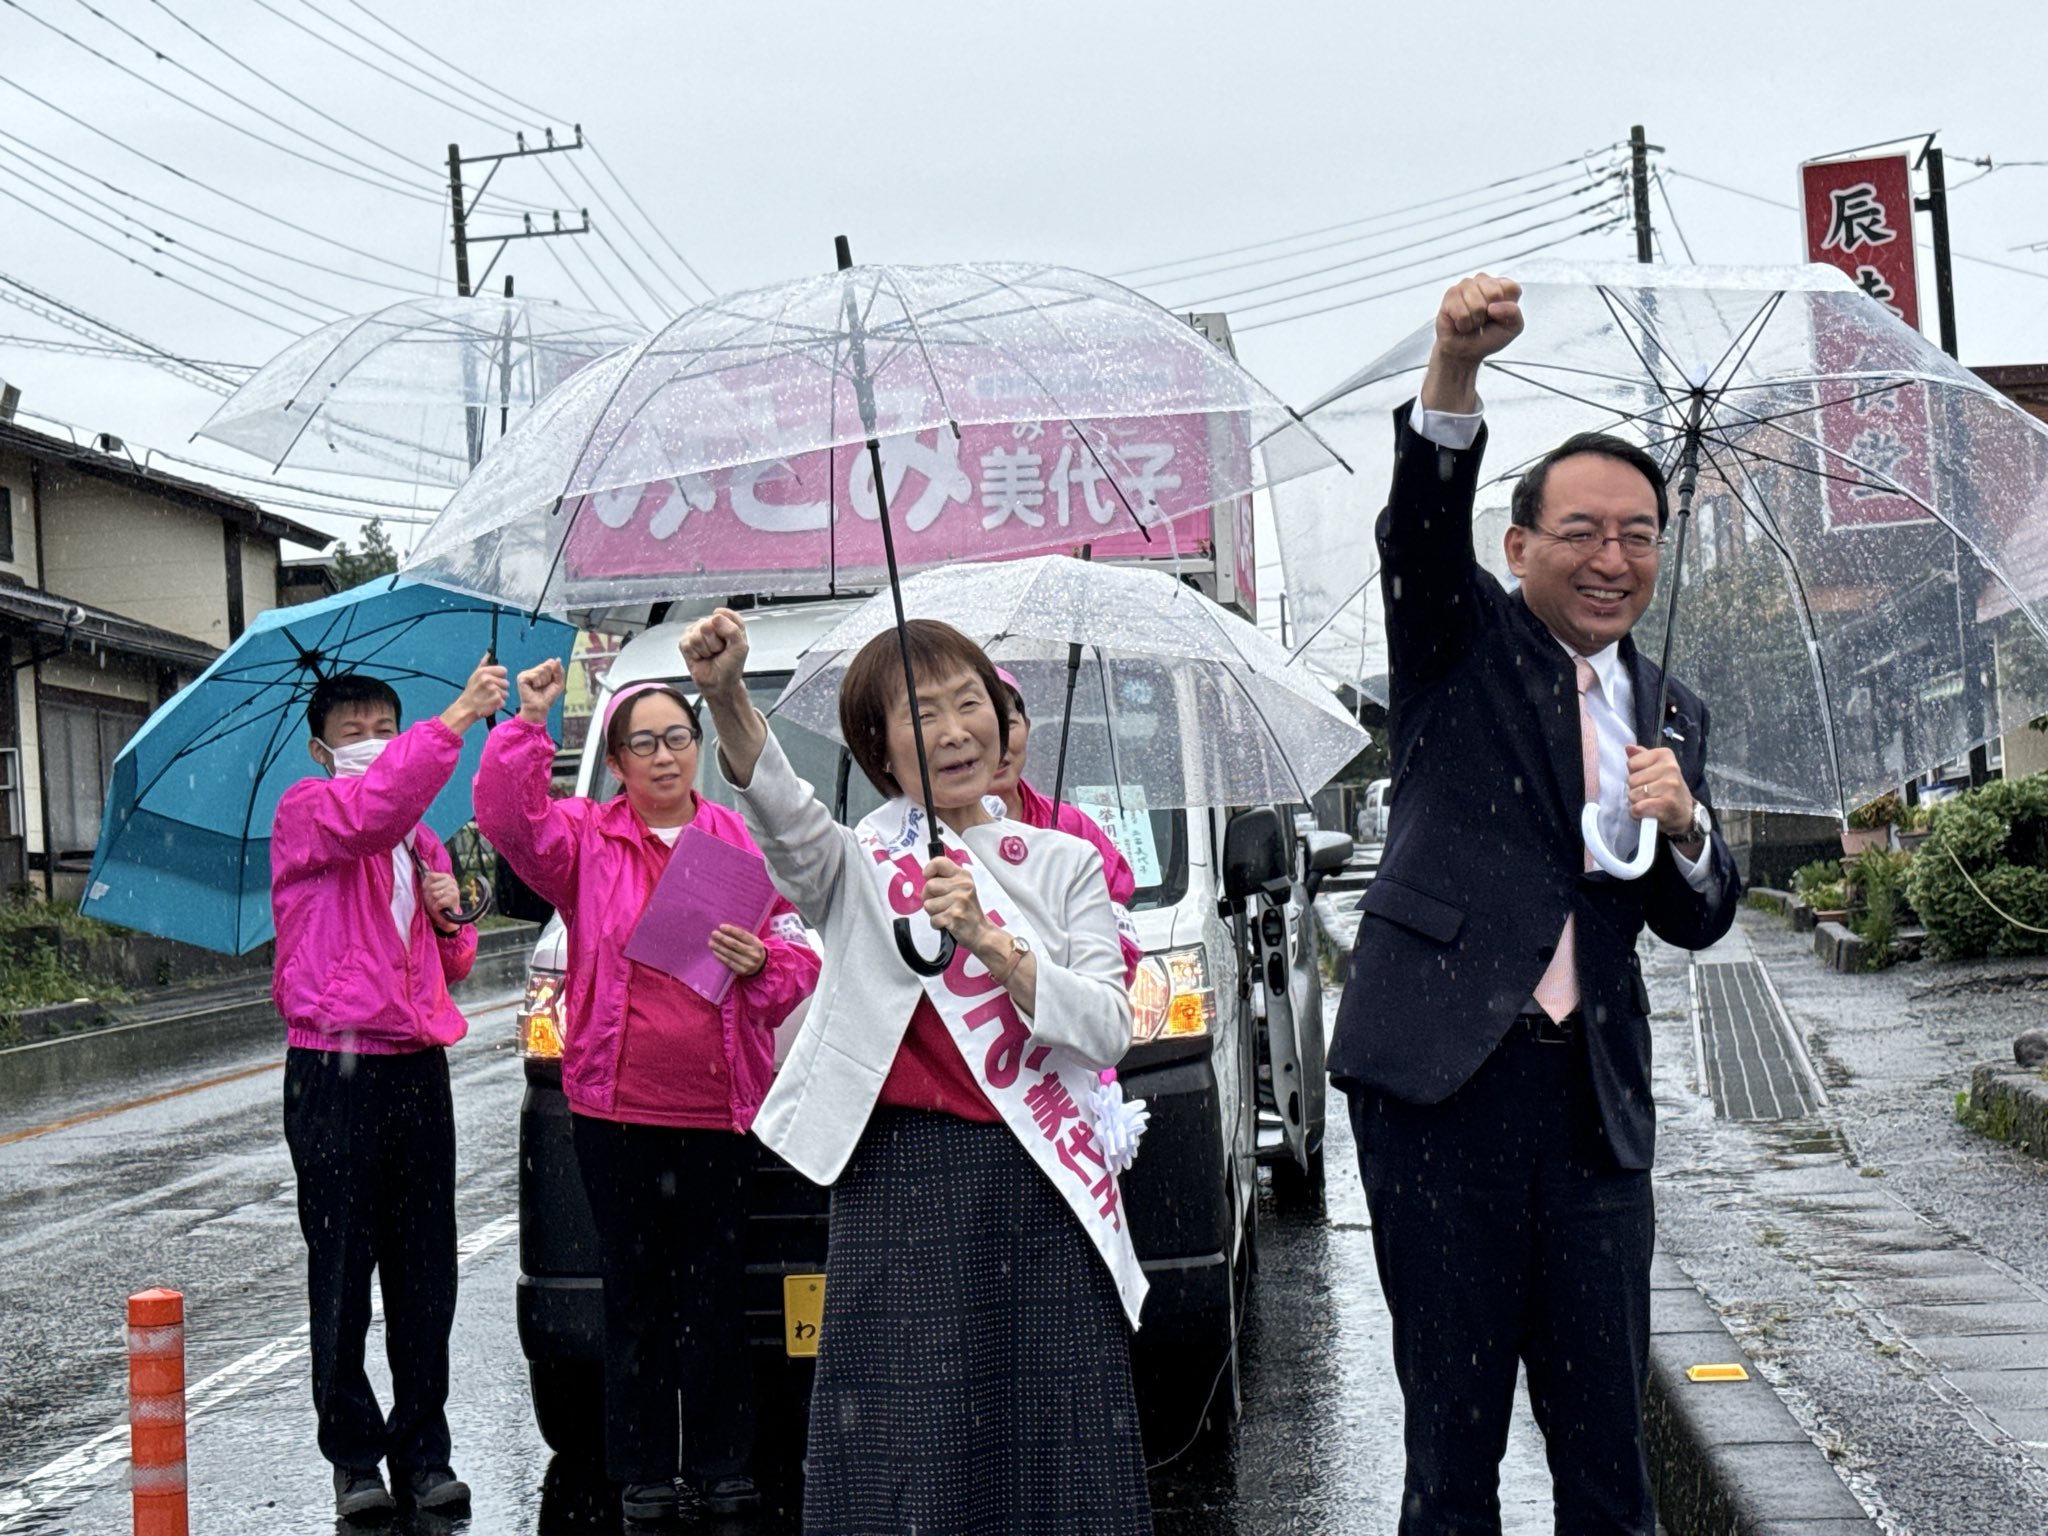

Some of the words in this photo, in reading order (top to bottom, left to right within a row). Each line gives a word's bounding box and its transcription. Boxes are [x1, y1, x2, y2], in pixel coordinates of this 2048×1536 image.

[979, 443, 1182, 531] 美代子
[794, 1319, 817, 1341] わ
